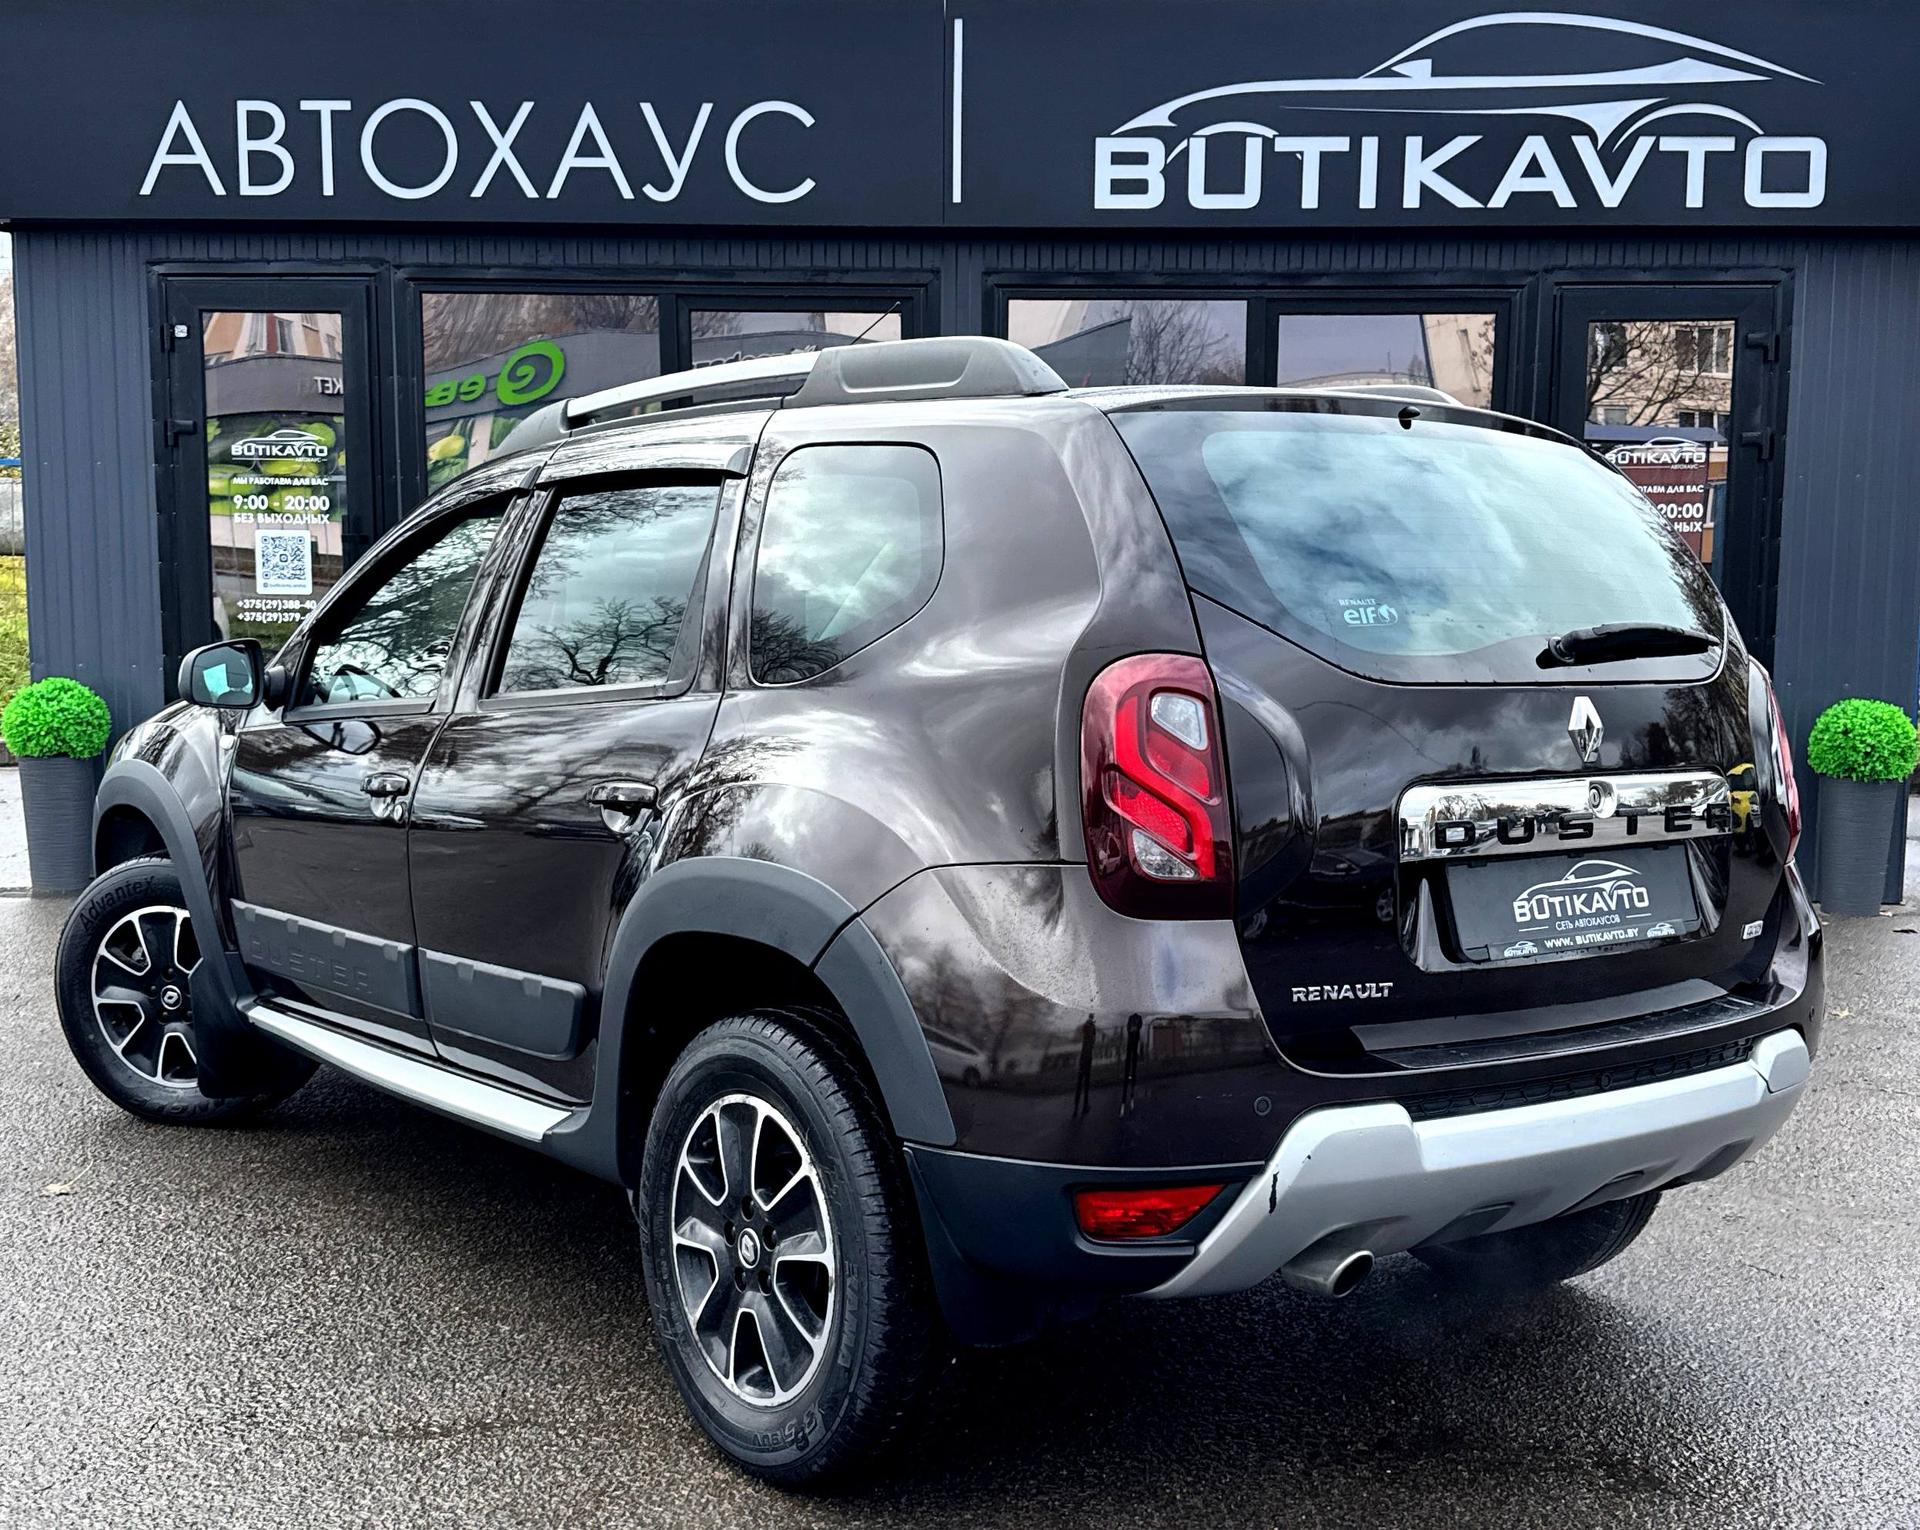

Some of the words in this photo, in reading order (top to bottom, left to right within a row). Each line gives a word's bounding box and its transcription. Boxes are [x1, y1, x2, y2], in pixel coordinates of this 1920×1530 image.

[139, 98, 817, 204] АВТОХАУС
[1093, 135, 1827, 210] BUTIKAVTO
[231, 444, 328, 457] BUTIKAVTO
[232, 477, 248, 485] МЫ
[248, 477, 292, 485] РАБОТАЕМ
[292, 478, 311, 486] ДЛЯ
[311, 478, 329, 486] ВАС
[1666, 485, 1685, 494] ДЛЯ
[1686, 484, 1704, 493] ВАС
[233, 494, 269, 510] 9:00
[284, 495, 330, 511] 20:00
[1656, 503, 1704, 519] 20:00
[233, 512, 254, 524] БЕЗ
[256, 512, 330, 525] ВЫХОДНЫХ
[1343, 606, 1378, 625] elf
[1434, 802, 1733, 850] DUSTER
[1513, 886, 1650, 923] BUTIKAVTO
[1555, 919, 1574, 931] СЕТЬ
[1574, 913, 1621, 929] АВТОХАУСОВ
[1544, 936, 1574, 949] WWW.
[1575, 927, 1639, 945] BUTIKAVTO.BY
[1291, 982, 1394, 1002] RENAULT
